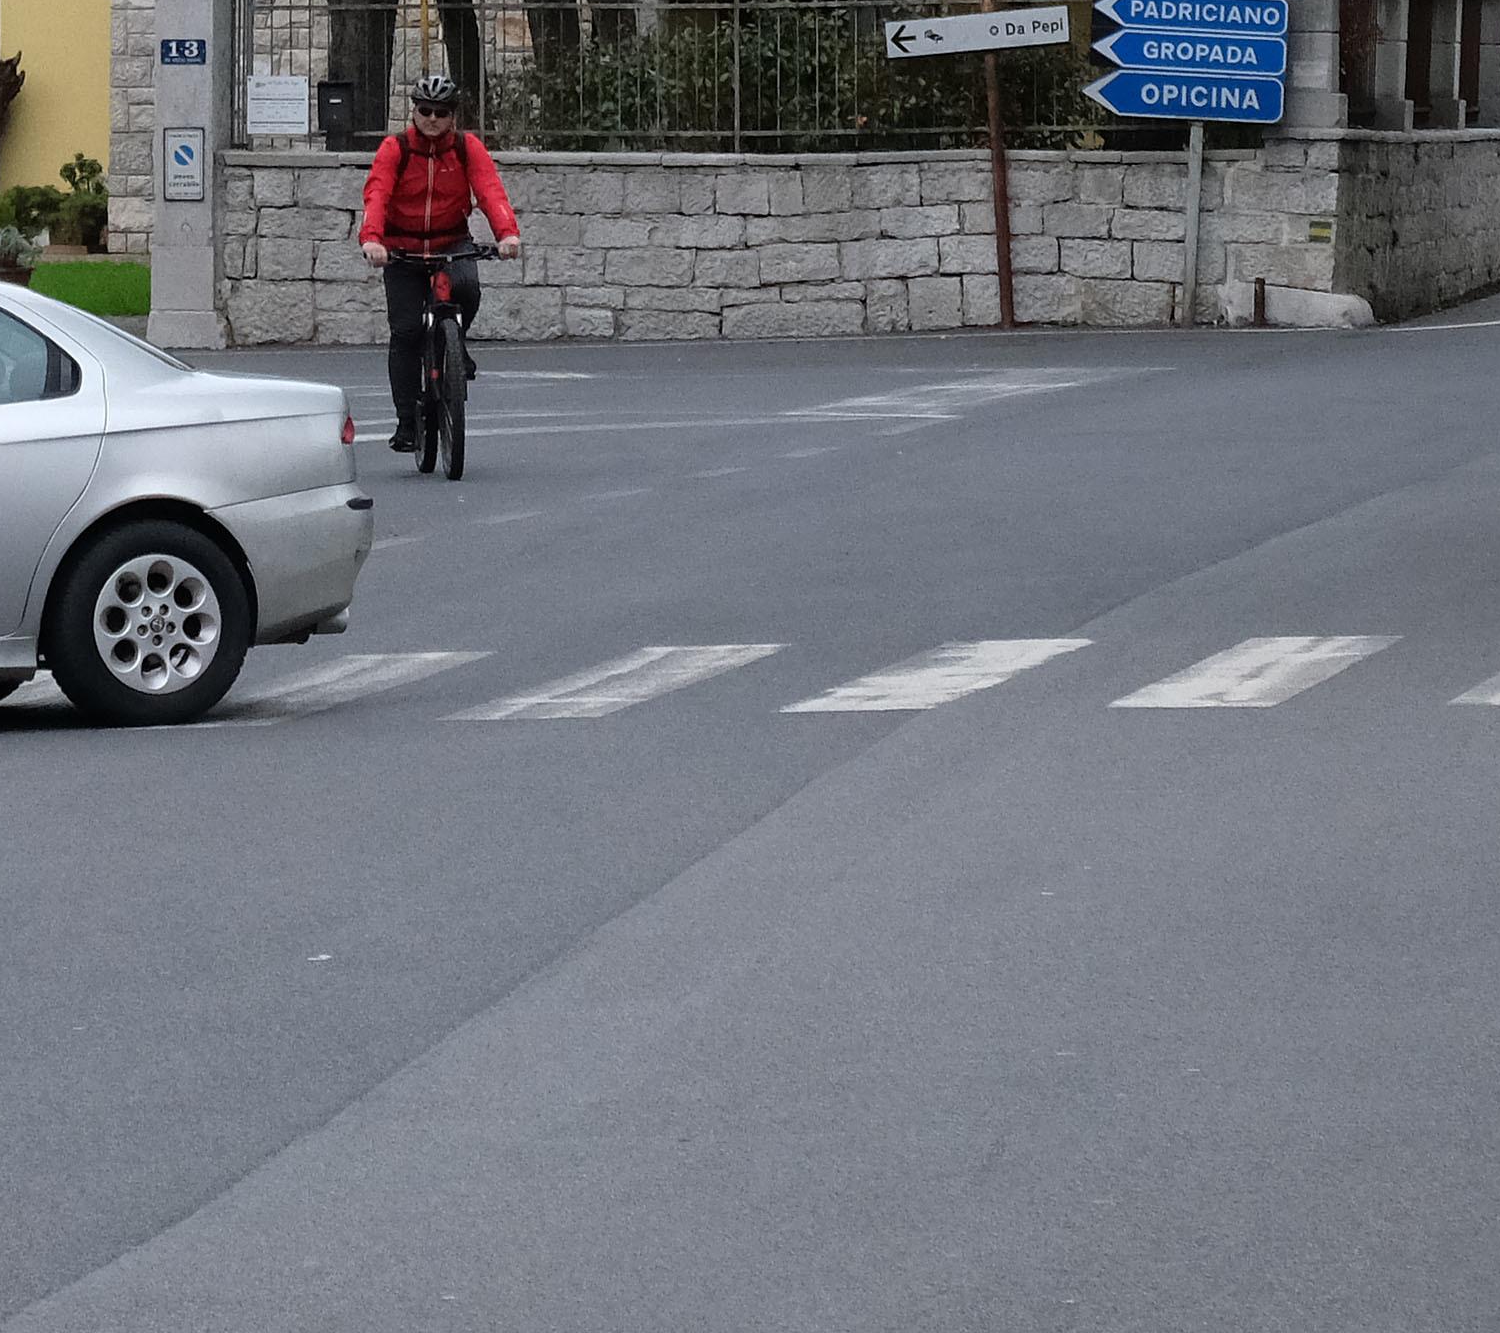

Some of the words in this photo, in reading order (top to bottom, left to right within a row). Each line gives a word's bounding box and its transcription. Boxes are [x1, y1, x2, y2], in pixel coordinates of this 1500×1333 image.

[1130, 0, 1280, 25] PADRICIANO
[1005, 22, 1025, 36] Da
[1032, 17, 1064, 34] Pepi
[168, 41, 199, 57] 13
[1143, 40, 1258, 65] GROPADA
[1140, 83, 1260, 110] OPICINA
